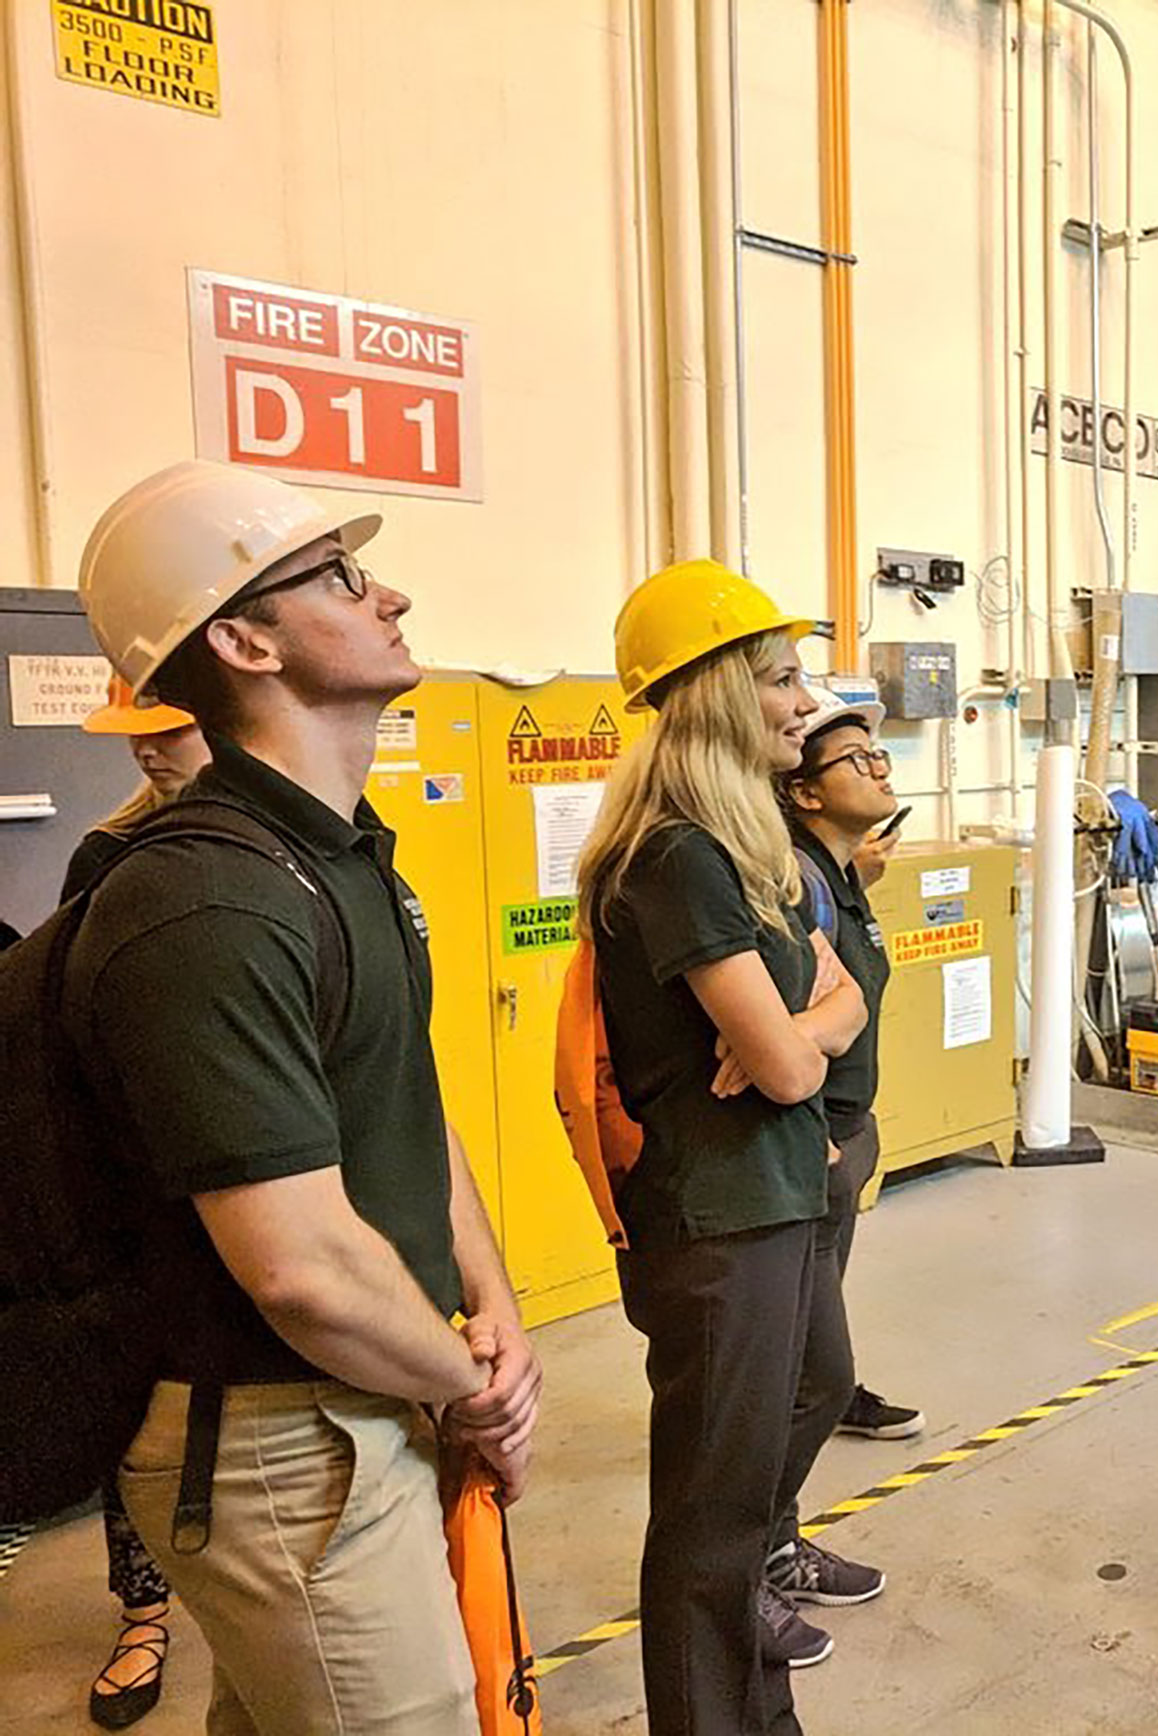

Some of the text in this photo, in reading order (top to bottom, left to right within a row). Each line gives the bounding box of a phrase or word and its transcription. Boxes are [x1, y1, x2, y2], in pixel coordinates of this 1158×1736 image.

[60, 0, 209, 41] UTION
[60, 10, 123, 43] 3500
[83, 40, 197, 85] FLOOR
[65, 56, 216, 110] LOADING
[228, 296, 459, 368] FIRE ZONE
[39, 683, 91, 696] GROUND
[32, 702, 92, 715] TEST EQ
[507, 736, 622, 764] FLAMMABLE
[508, 767, 544, 785] KEEP
[551, 766, 581, 783] FIRE
[509, 904, 577, 927] HAZARDO
[895, 922, 979, 949] FLAMMABLE
[896, 938, 979, 962] KEEP FIRE AWAY
